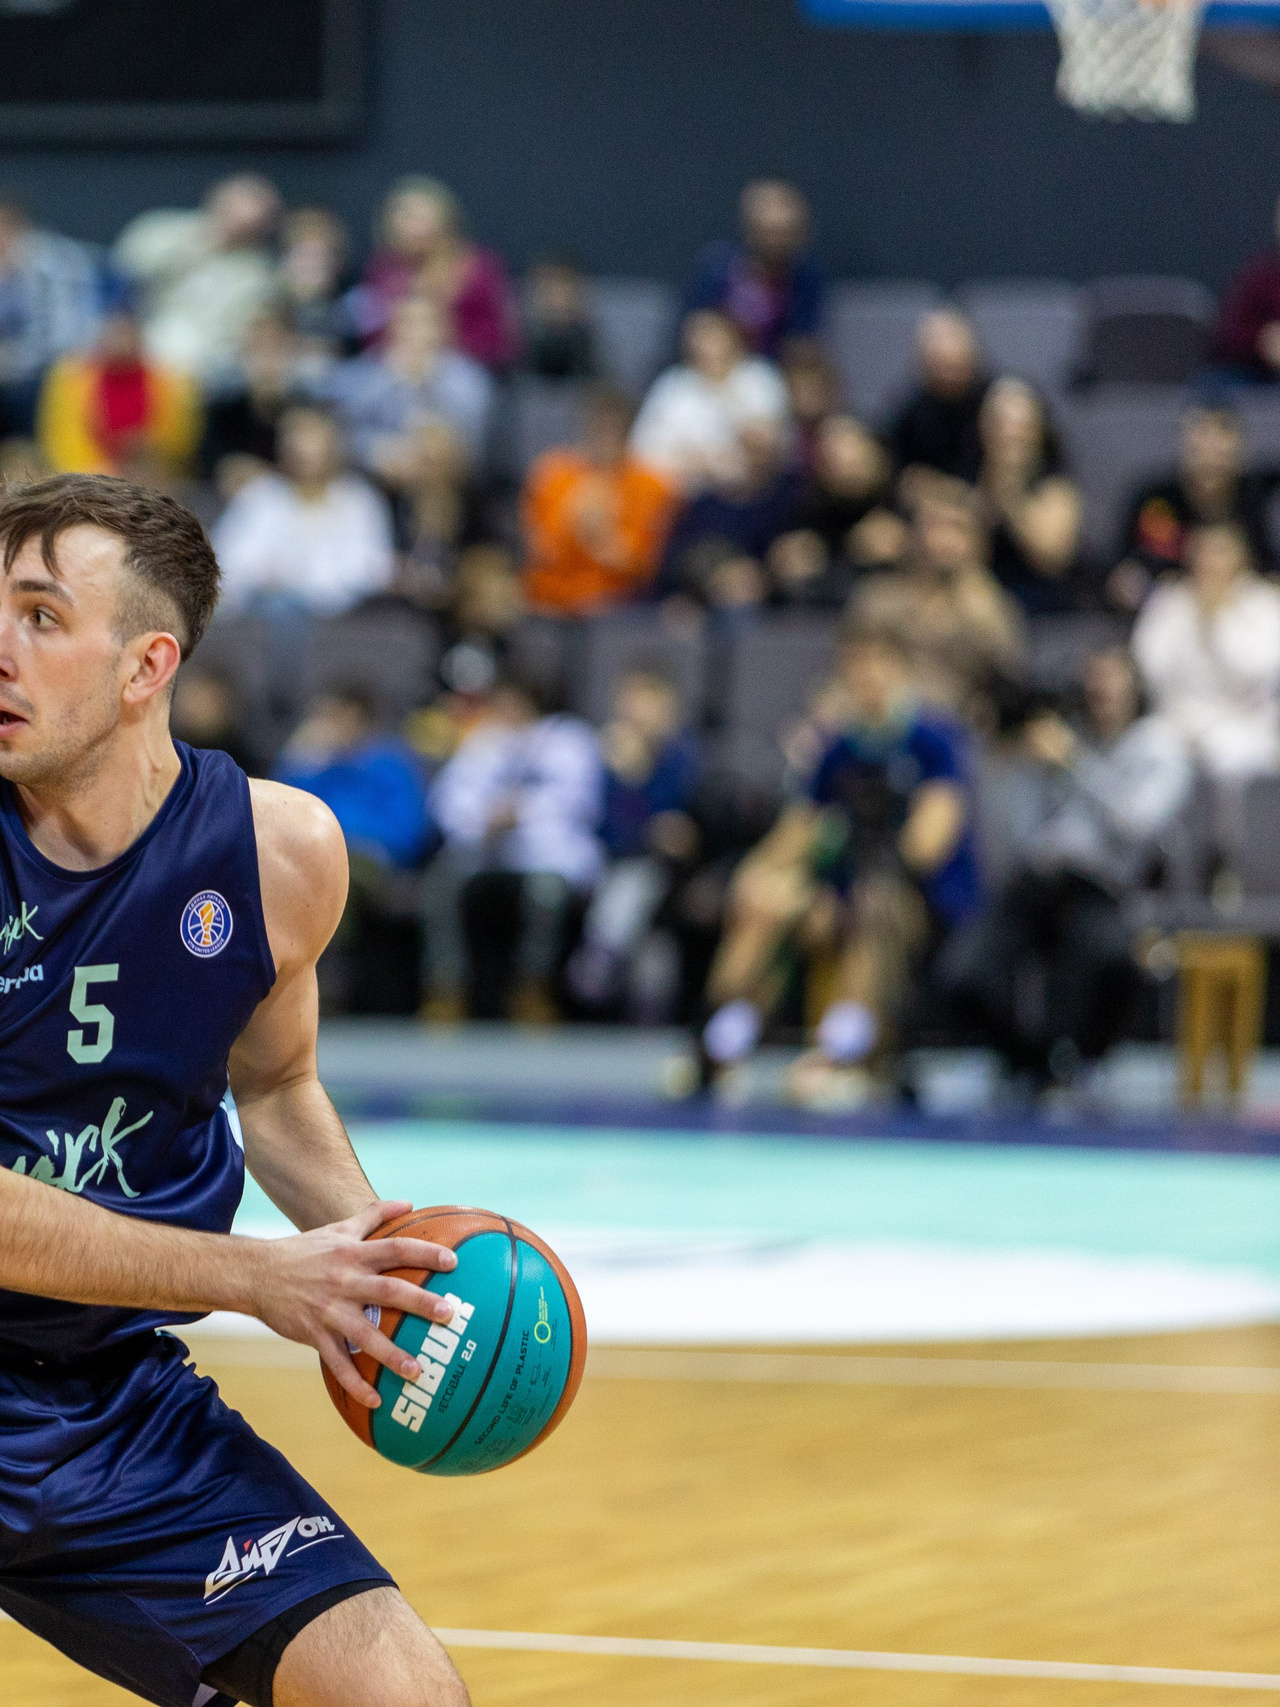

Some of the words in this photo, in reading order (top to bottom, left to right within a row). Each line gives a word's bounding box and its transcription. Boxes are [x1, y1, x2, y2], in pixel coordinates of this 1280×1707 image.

[67, 963, 119, 1064] 5
[391, 1292, 475, 1433] SIBUR
[461, 1339, 477, 1362] 2.0
[474, 1414, 501, 1446] SECOND
[498, 1392, 513, 1415] LIFE
[509, 1377, 518, 1391] OF
[515, 1329, 530, 1375] PLASTIC
